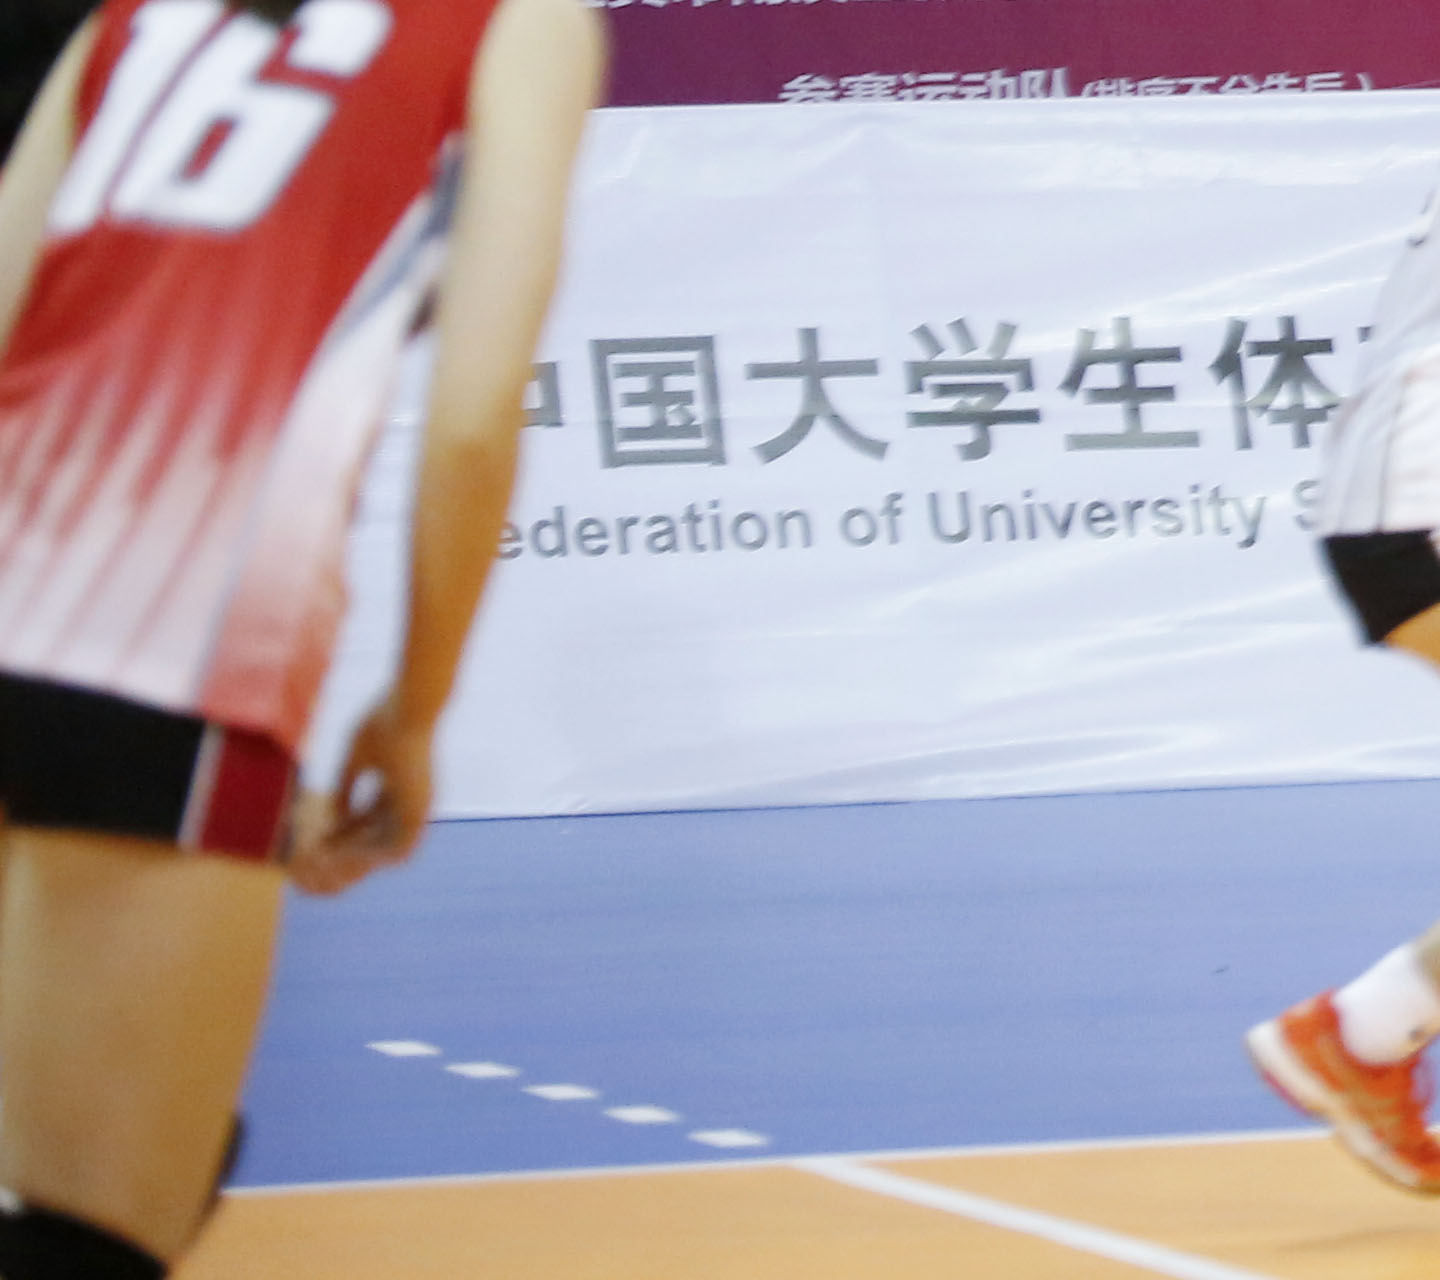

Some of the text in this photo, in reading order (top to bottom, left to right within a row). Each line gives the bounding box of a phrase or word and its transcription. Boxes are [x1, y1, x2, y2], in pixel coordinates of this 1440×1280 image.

[497, 497, 814, 561] ederation
[840, 491, 903, 547] of
[926, 481, 1268, 550] University
